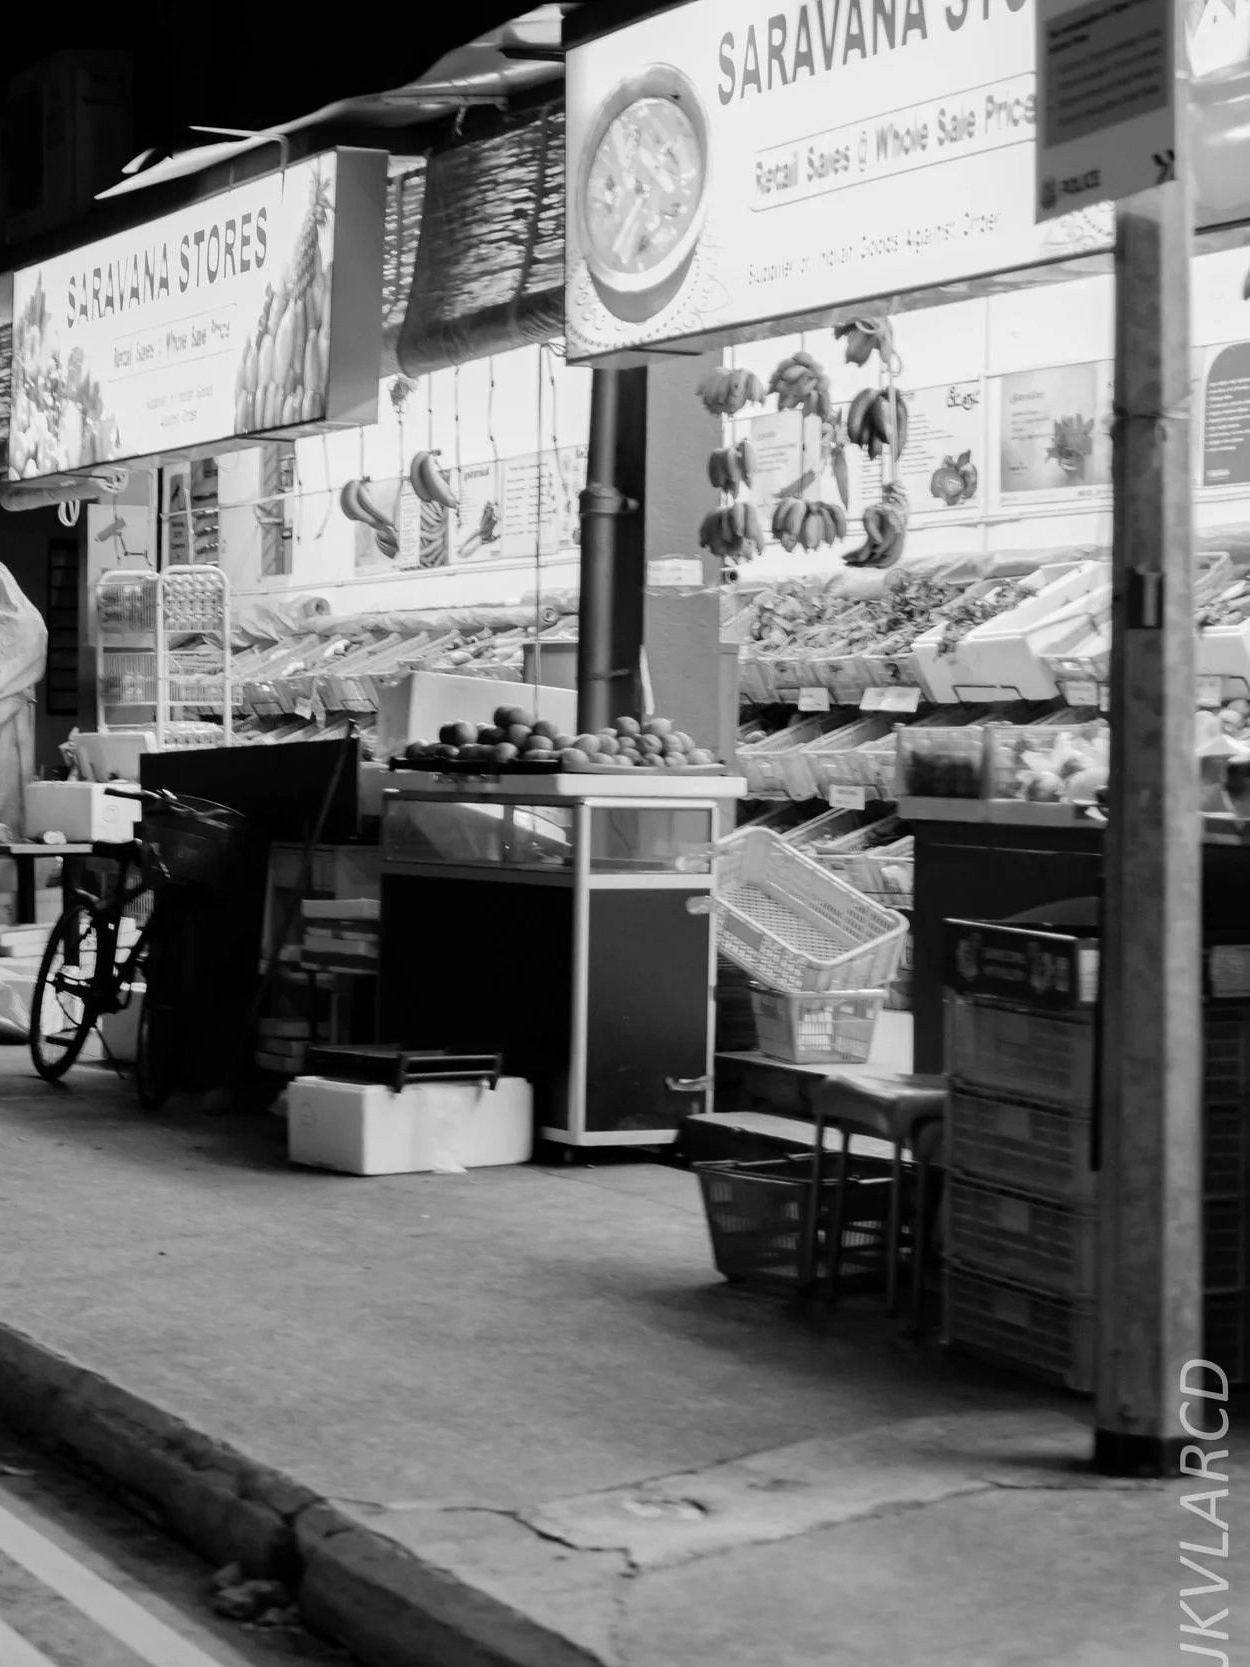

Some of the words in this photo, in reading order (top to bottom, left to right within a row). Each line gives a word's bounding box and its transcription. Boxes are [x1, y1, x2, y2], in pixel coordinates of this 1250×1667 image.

[718, 0, 928, 106] SARAVANA
[755, 152, 798, 195] Retail
[806, 145, 850, 182] Sales
[875, 114, 929, 162] Whole
[937, 102, 977, 146] Sale
[67, 242, 170, 329] SARAVANA
[179, 206, 267, 294] STORES
